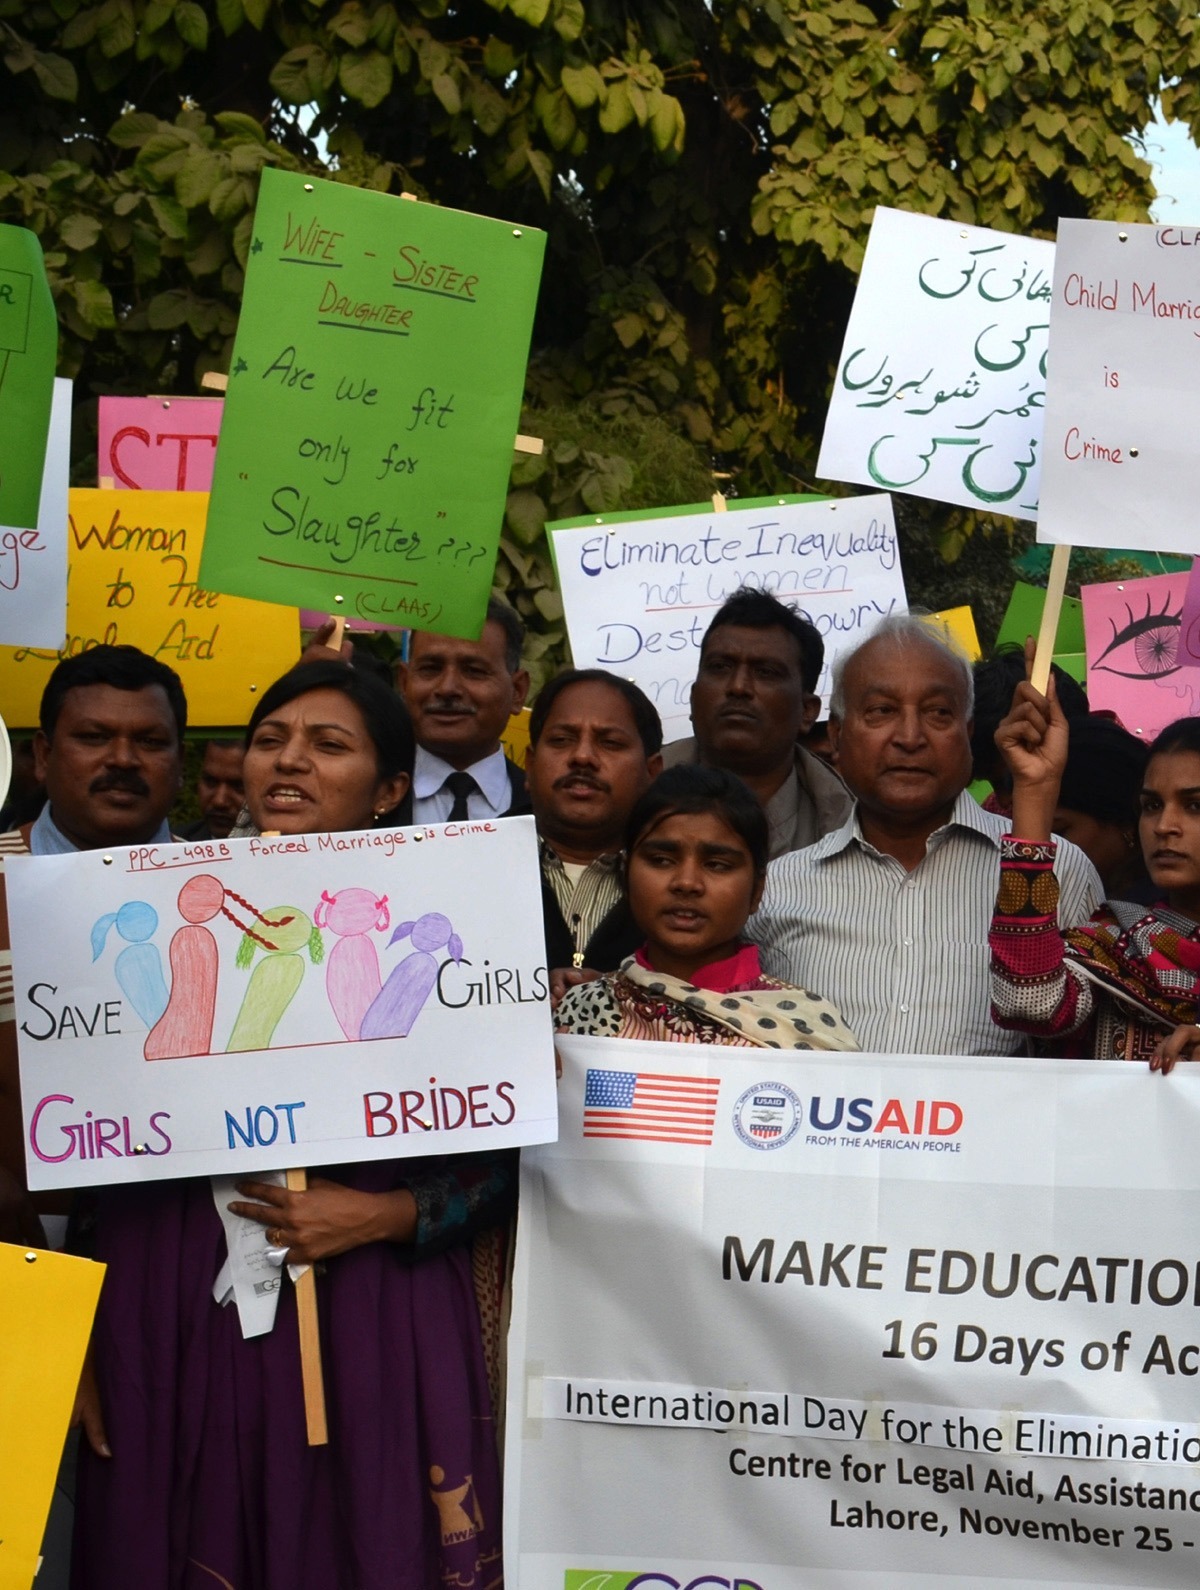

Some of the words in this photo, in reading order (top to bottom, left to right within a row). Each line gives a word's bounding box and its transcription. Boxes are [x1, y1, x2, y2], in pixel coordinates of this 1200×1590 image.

[319, 281, 413, 328] DAUGHTER
[1064, 273, 1118, 311] Child
[262, 347, 315, 390] Are
[406, 387, 453, 431] fit
[1104, 366, 1118, 387] is
[299, 436, 350, 485] only
[376, 443, 418, 479] for
[1065, 427, 1123, 463] Crime
[106, 568, 134, 608] to
[356, 592, 442, 624] (CLAAS)
[639, 571, 692, 605] not
[318, 834, 406, 857] Marriage
[423, 828, 435, 840] is
[444, 822, 498, 836] Crime
[21, 983, 122, 1041] SAVE
[756, 1098, 783, 1106] USAID
[809, 1097, 963, 1136] USAID
[226, 1102, 305, 1150] NOT
[806, 1136, 836, 1146] FROM
[840, 1137, 860, 1147] THE
[863, 1139, 919, 1151] AMERICAN
[923, 1142, 961, 1152] PEOPLE
[721, 1235, 887, 1290] MAKE
[882, 1320, 938, 1361] 16
[955, 1324, 1064, 1376] Days
[1081, 1332, 1130, 1372] of
[566, 1383, 790, 1427] International
[804, 1397, 867, 1439] Day
[881, 1408, 932, 1444] for
[943, 1416, 1002, 1452] the
[729, 1448, 832, 1481] Centre
[841, 1454, 885, 1484] for
[897, 1458, 974, 1494] Legal
[984, 1470, 1045, 1501] Aid,
[830, 1500, 949, 1537] Lahore,
[959, 1507, 1124, 1548] November
[1134, 1525, 1173, 1551] 25
